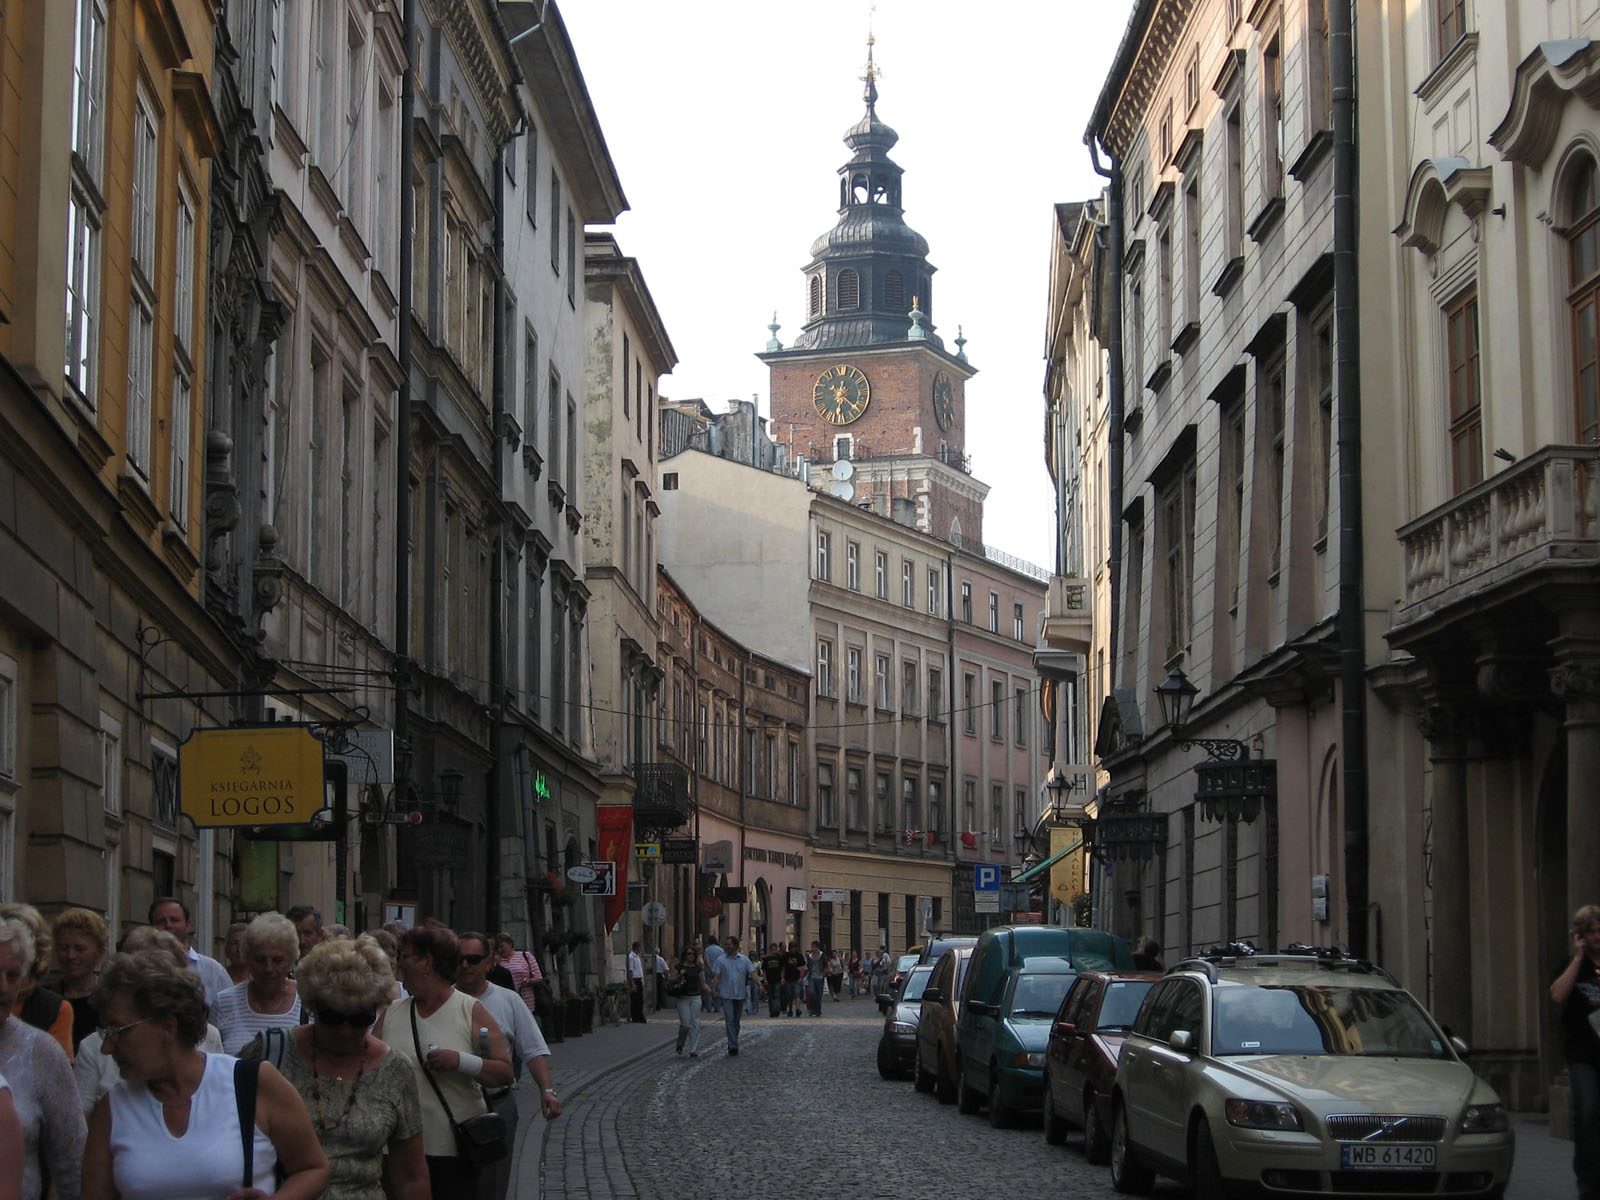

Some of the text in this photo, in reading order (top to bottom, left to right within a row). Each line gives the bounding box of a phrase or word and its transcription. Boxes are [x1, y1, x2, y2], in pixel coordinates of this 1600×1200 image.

[209, 780, 295, 793] KSIĘGARNIA
[209, 795, 295, 817] LOGOS
[980, 867, 995, 888] P
[1353, 1147, 1433, 1164] WB 61420
